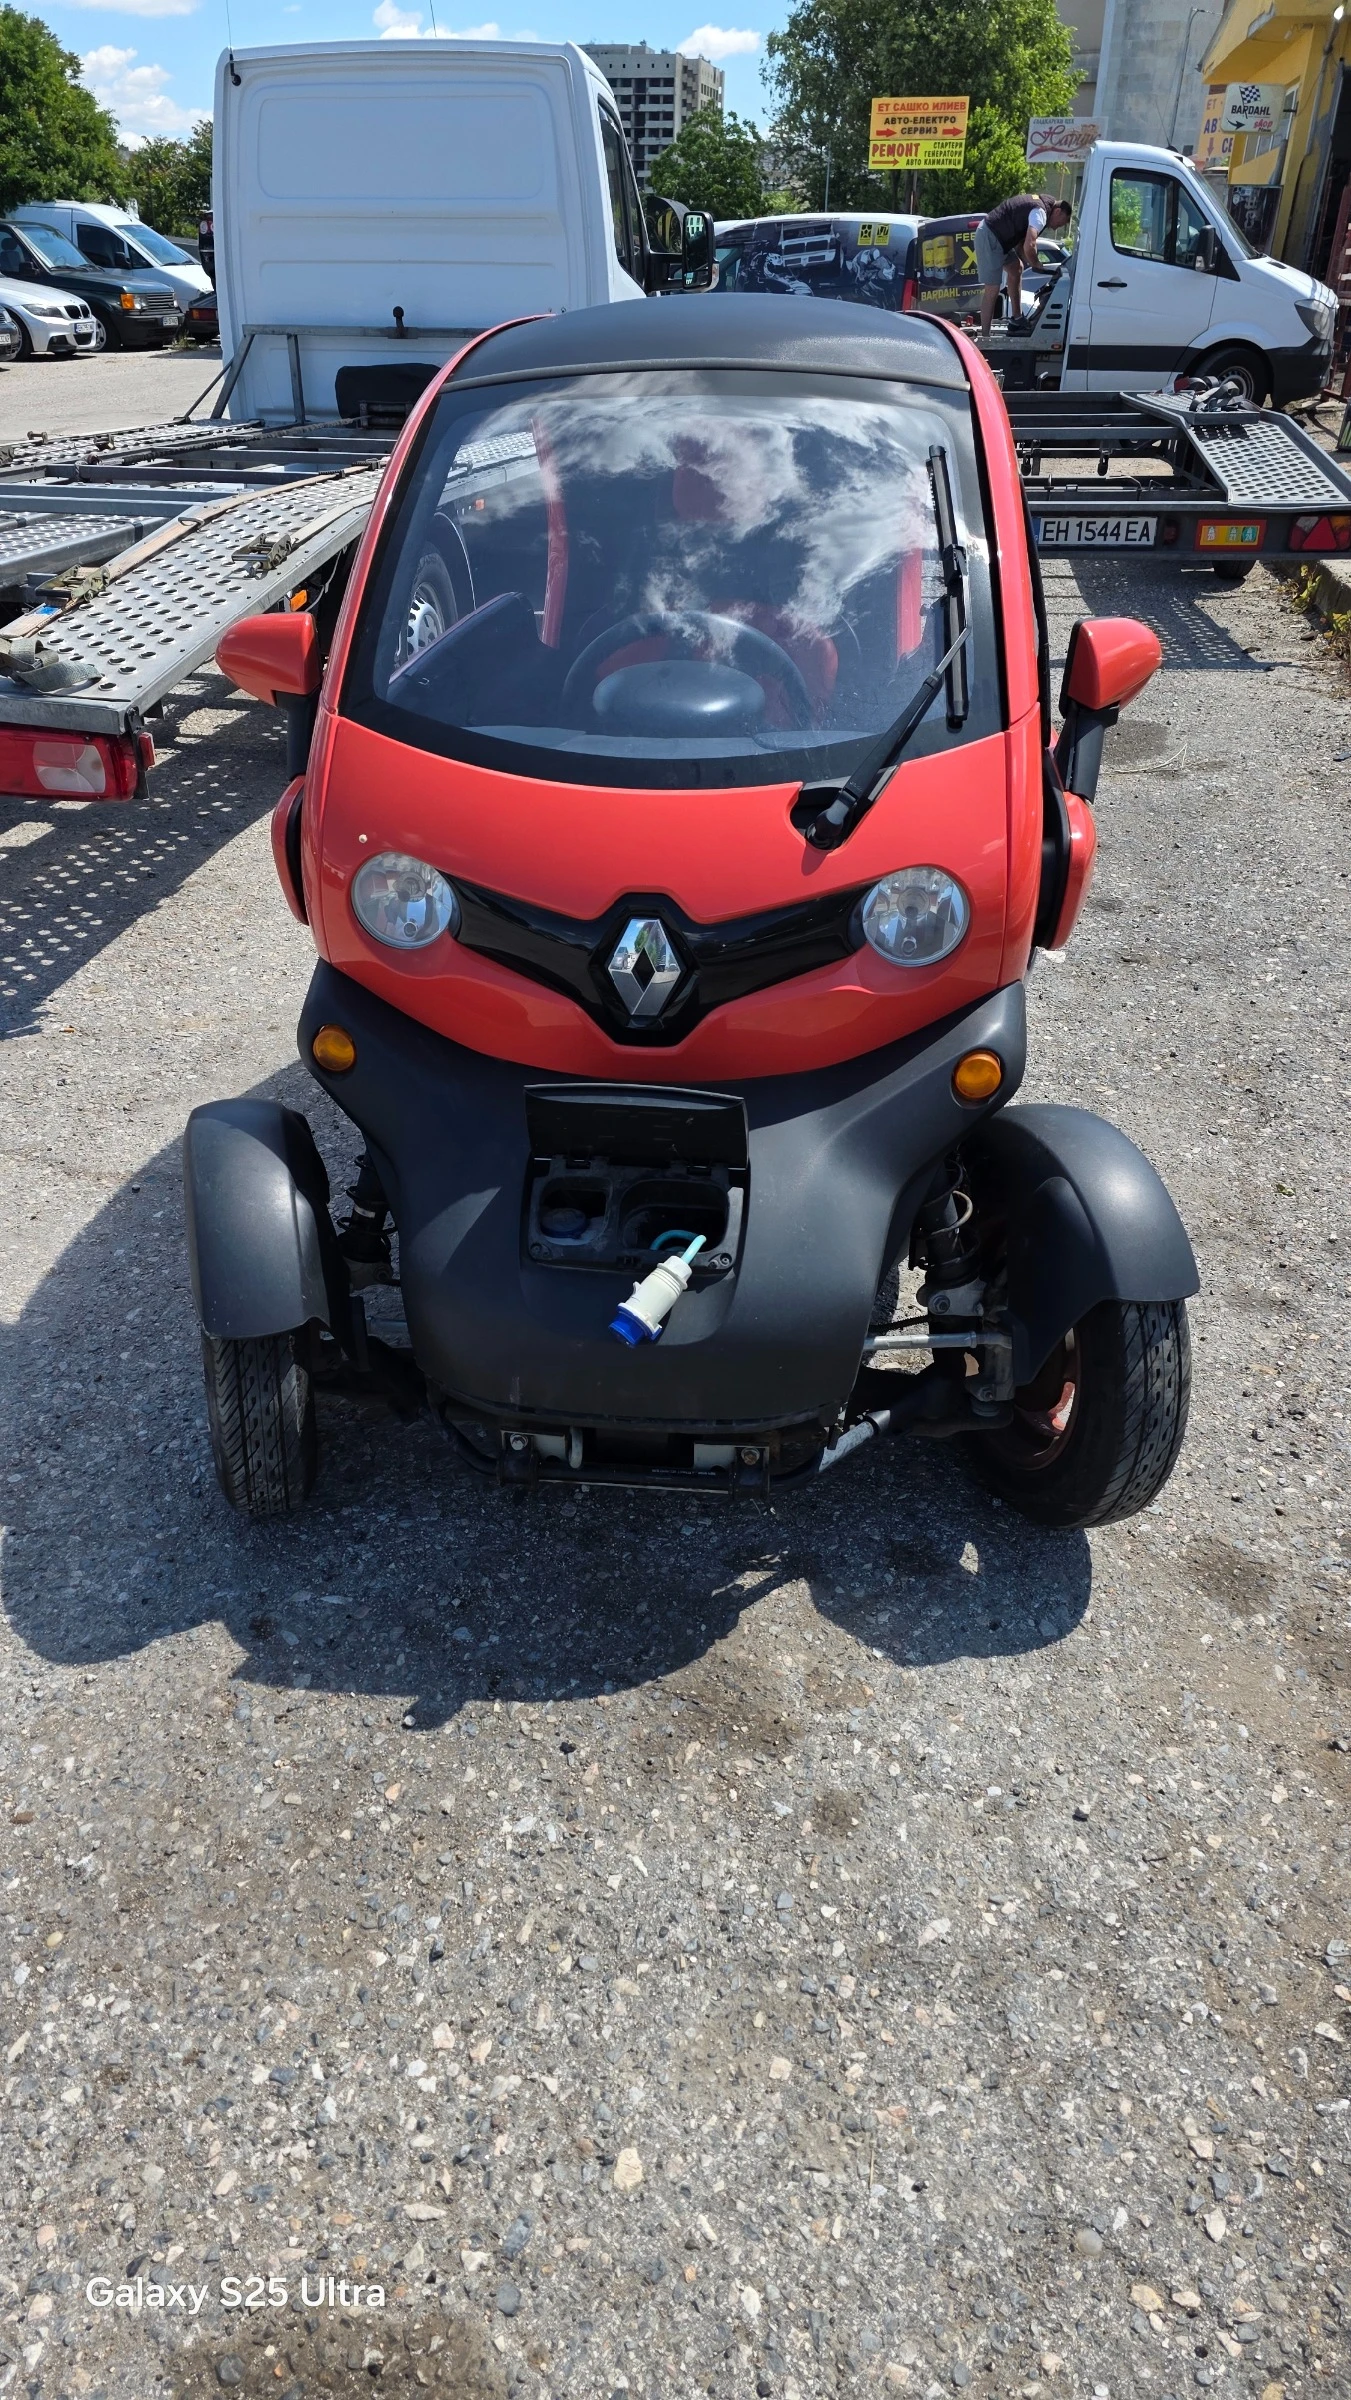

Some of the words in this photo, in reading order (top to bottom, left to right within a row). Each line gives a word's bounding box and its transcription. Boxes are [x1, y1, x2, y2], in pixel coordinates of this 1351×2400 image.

[878, 103, 890, 112] ЕТ
[893, 102, 929, 112] САШКО
[932, 101, 966, 111] ИЛИЕВ
[1231, 105, 1271, 117] BARDAHL
[884, 116, 956, 125] АВТО-ЕЛЕКТРО
[900, 127, 938, 135] СЕРВИЗ
[933, 141, 963, 149] СТАРТЕРИ
[871, 143, 920, 158] РЕМОНТ
[924, 150, 963, 158] ГЕНЕРАТОРИ
[905, 158, 922, 166] АВТО
[923, 158, 961, 167] КЛИМАТИЦИ
[921, 288, 960, 301] BARDAHL
[1042, 521, 1069, 542] EH
[1076, 521, 1121, 541] 1544
[1124, 520, 1150, 541] EA
